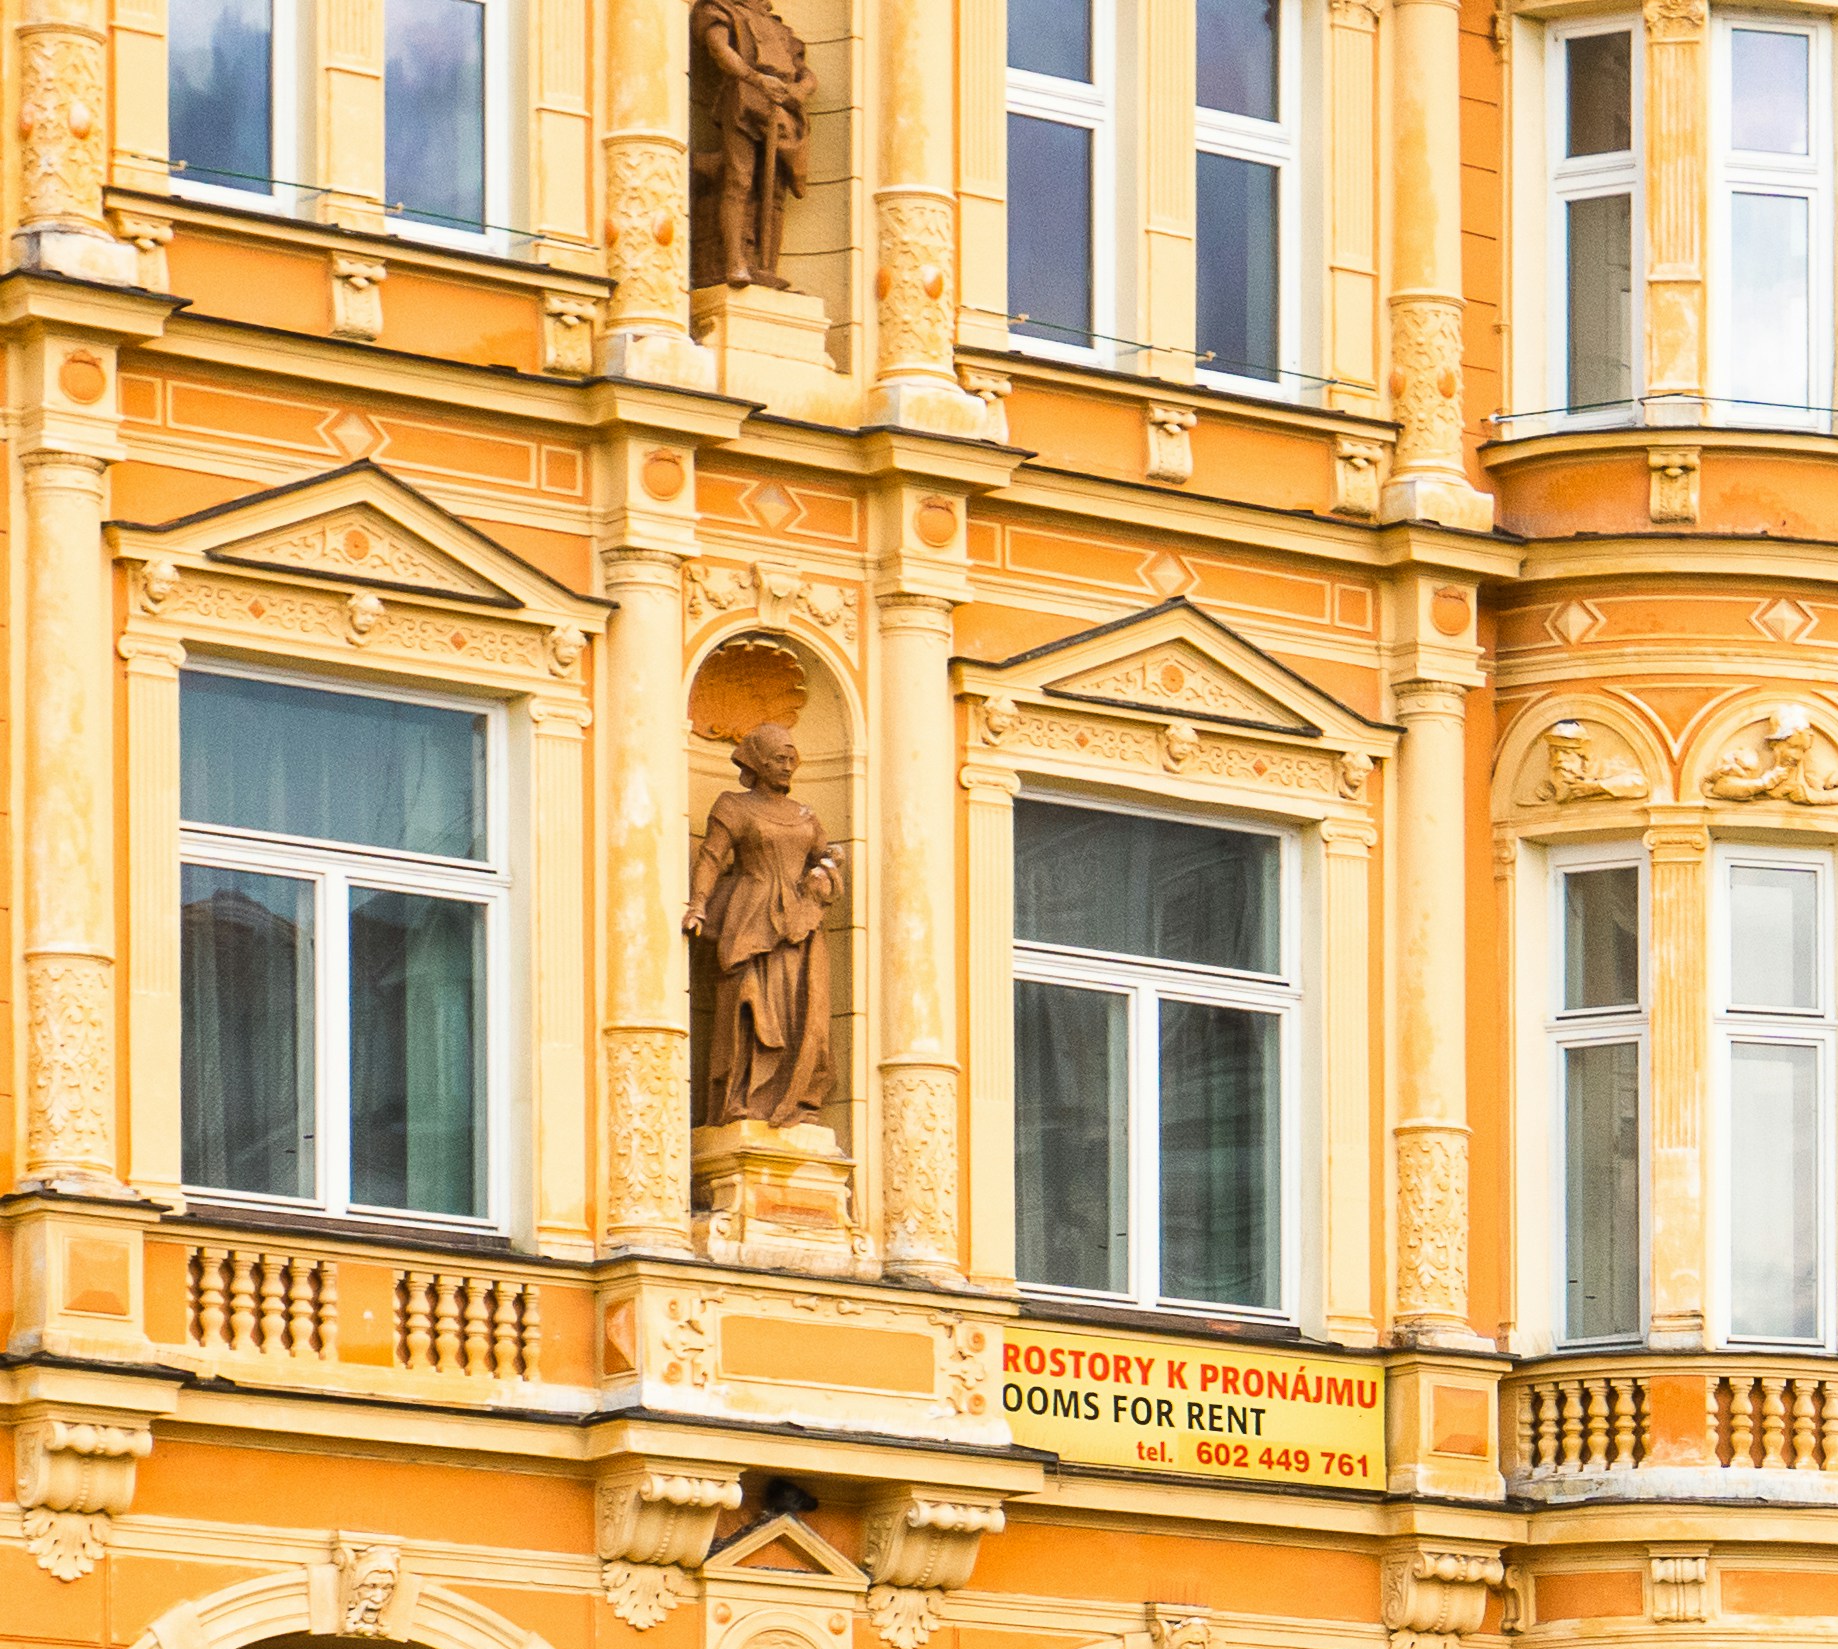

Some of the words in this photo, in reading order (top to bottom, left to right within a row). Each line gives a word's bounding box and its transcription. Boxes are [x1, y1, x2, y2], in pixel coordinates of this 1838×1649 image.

[1167, 1361, 1188, 1389] K
[1200, 1364, 1377, 1408] PRONÁJMU
[1113, 1395, 1175, 1428] FOR
[1188, 1401, 1266, 1436] RENT
[1137, 1441, 1173, 1463] tel.
[1197, 1441, 1249, 1468] 602
[1259, 1446, 1309, 1473] 449
[1320, 1451, 1369, 1477] 761
